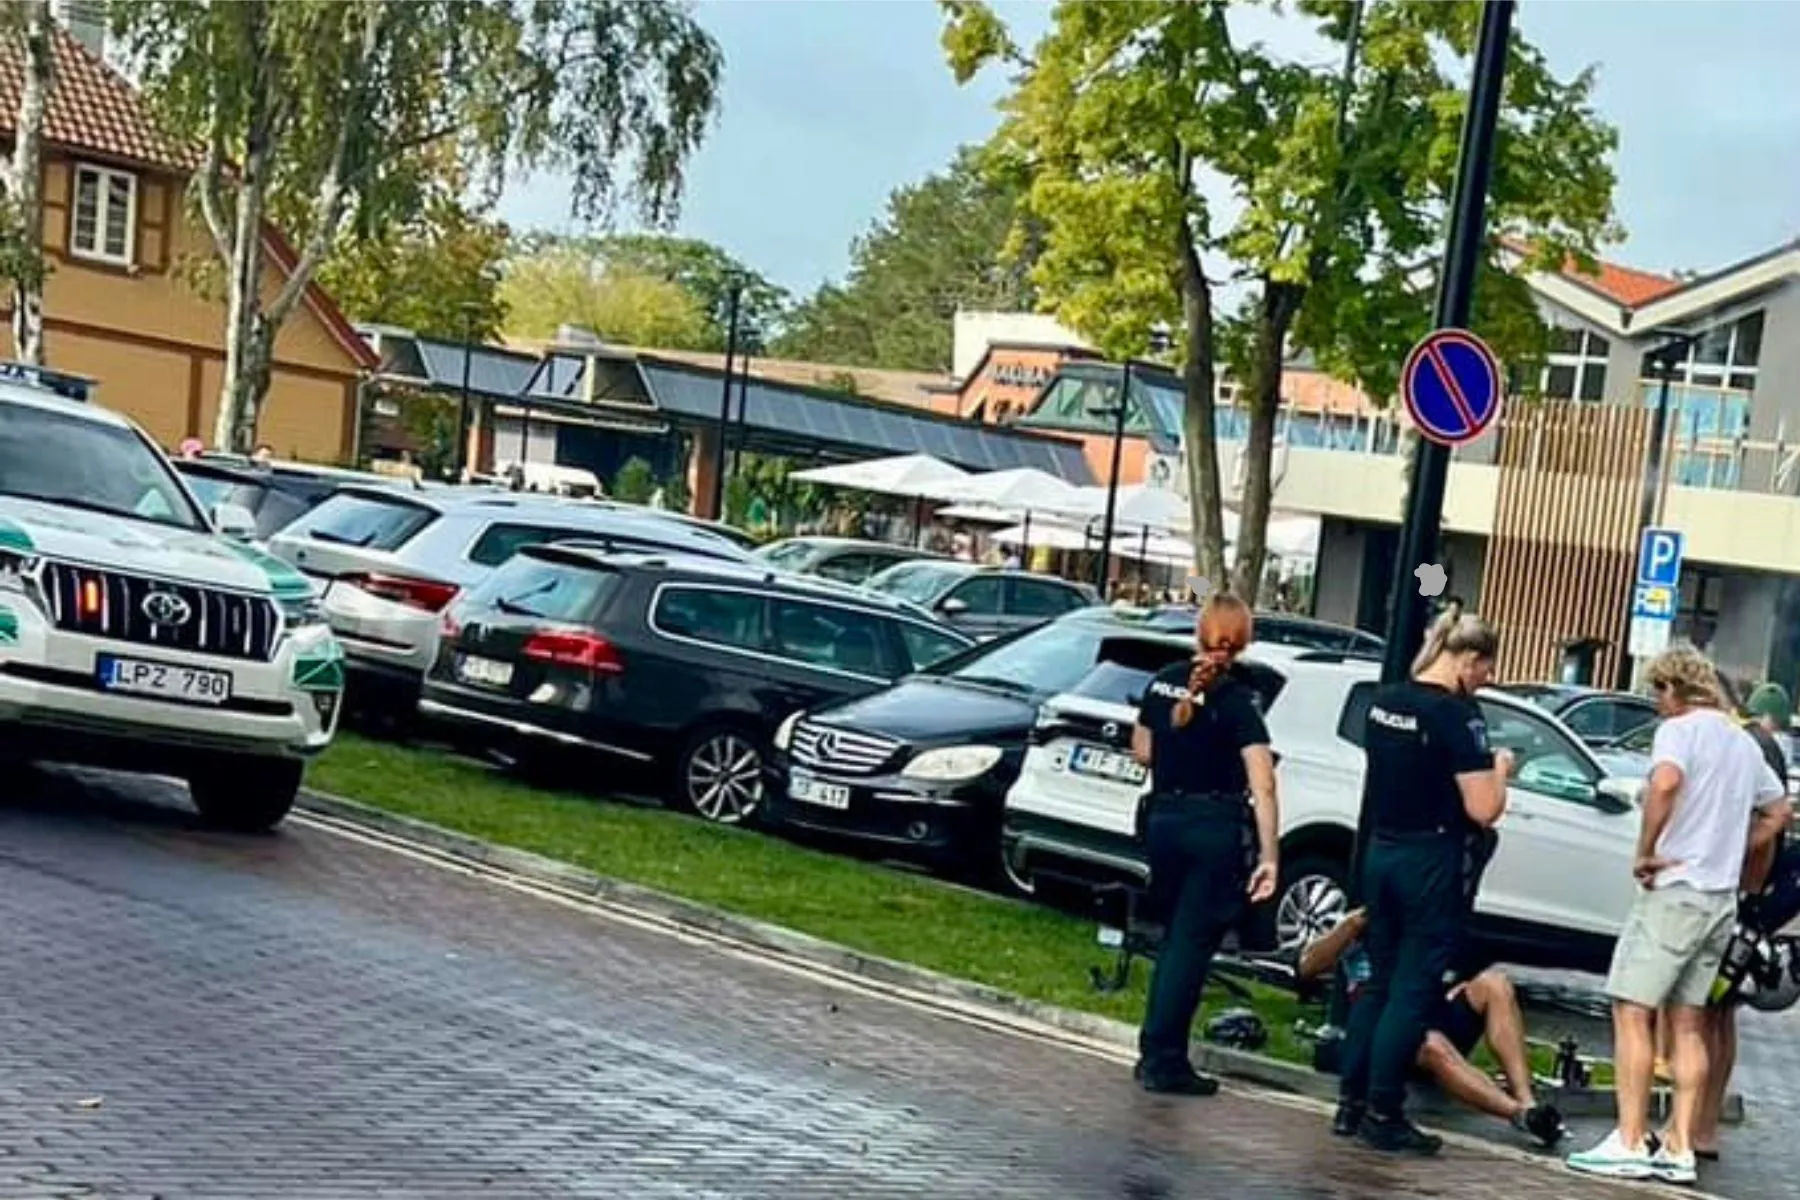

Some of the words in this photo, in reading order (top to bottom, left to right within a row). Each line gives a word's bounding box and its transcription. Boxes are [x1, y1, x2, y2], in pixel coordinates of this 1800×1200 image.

[1650, 535, 1675, 579] P
[115, 661, 167, 688] LPZ
[182, 671, 224, 696] 790
